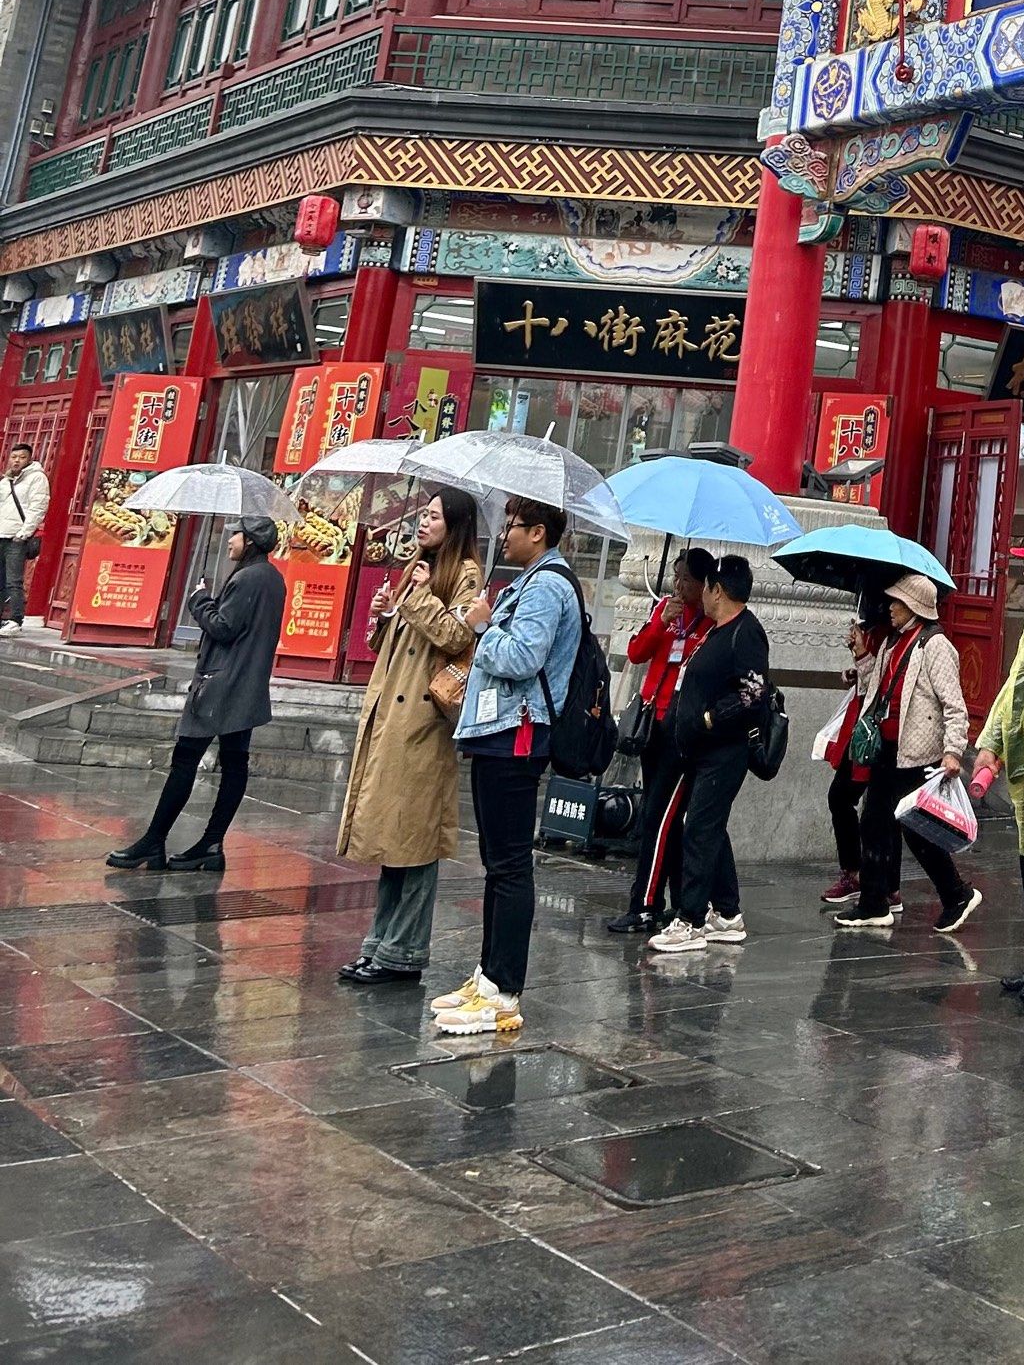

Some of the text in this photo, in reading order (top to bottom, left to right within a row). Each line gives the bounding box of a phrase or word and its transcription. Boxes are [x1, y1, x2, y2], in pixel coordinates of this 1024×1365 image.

[503, 299, 742, 363] 十八街麻花
[138, 396, 163, 446] 十八街
[330, 387, 356, 446] 十八街
[387, 398, 428, 440] 小八
